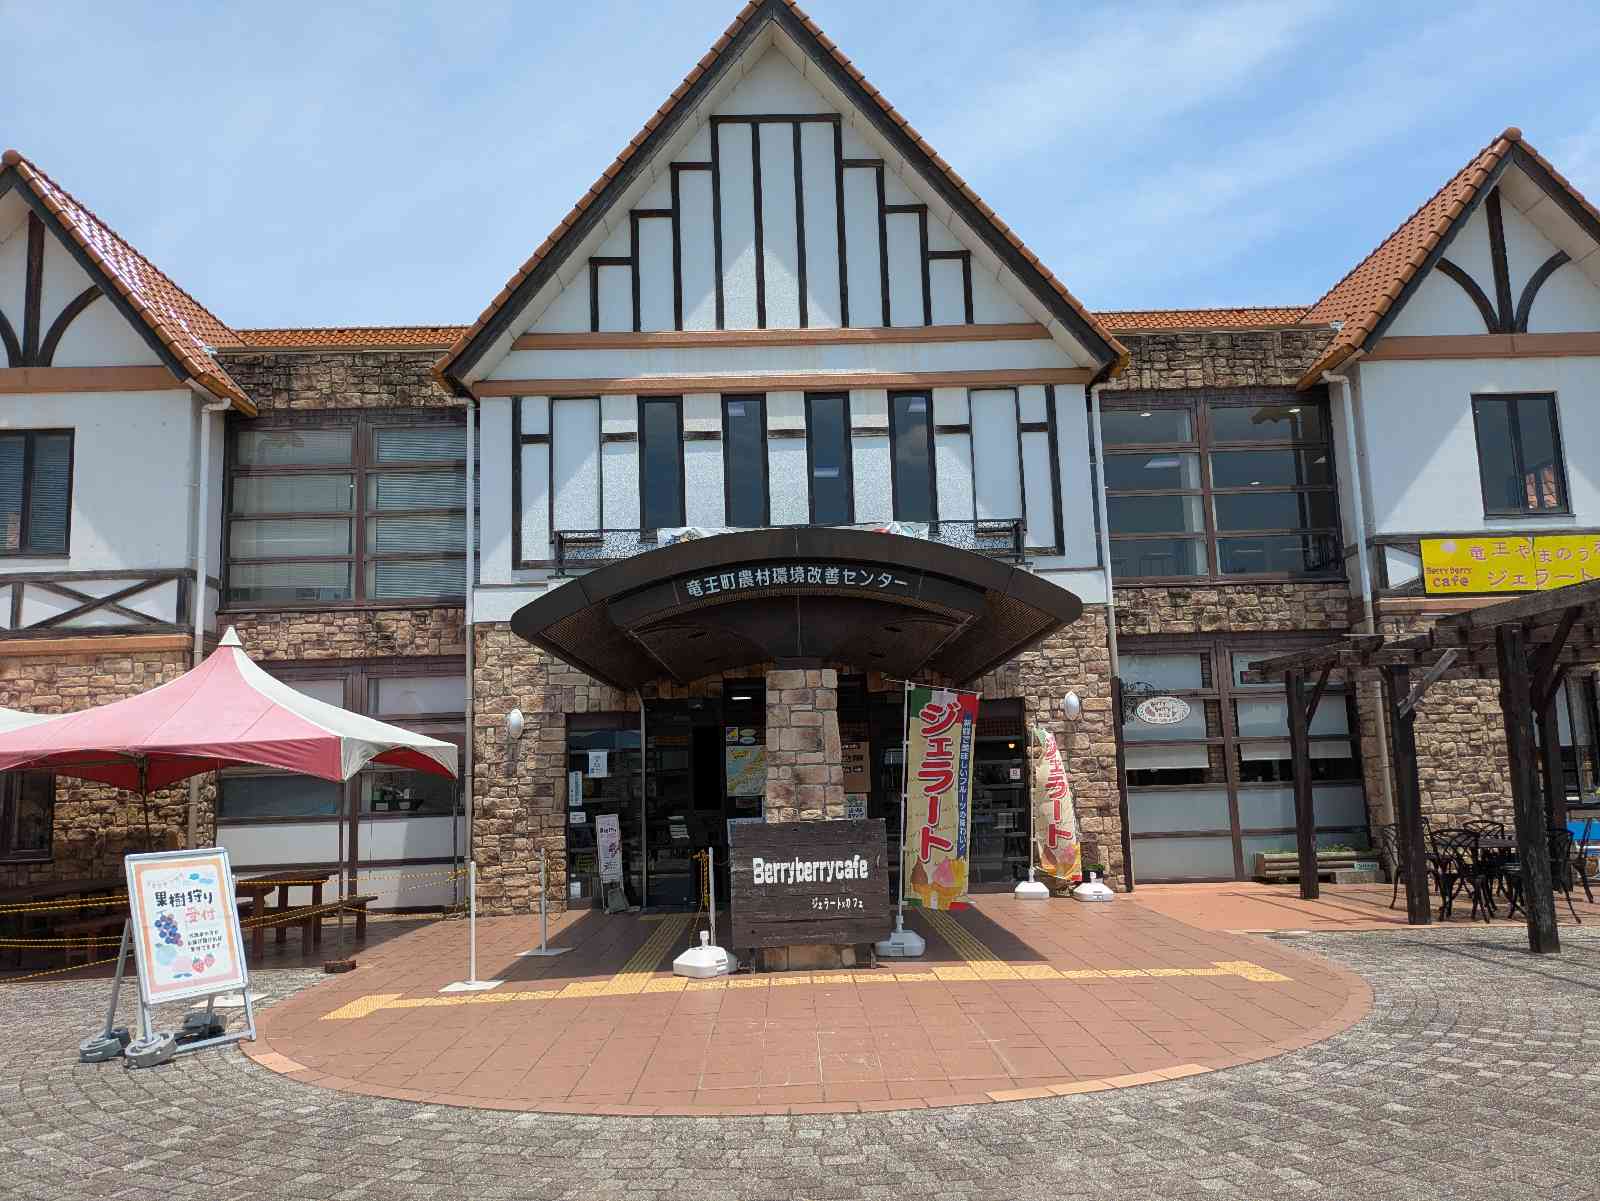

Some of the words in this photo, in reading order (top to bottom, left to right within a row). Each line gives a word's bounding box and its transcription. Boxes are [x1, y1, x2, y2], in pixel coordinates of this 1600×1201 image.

[685, 566, 909, 598] 竜王町農村環境改善センター
[1433, 576, 1469, 588] cafe
[1488, 567, 1594, 586] ジェラート
[917, 702, 962, 862] ジェラート
[1044, 735, 1073, 849] ジェラート
[752, 854, 869, 885] Berryberrycafe
[154, 889, 213, 908] 果樹狩り
[185, 907, 216, 922] 受付
